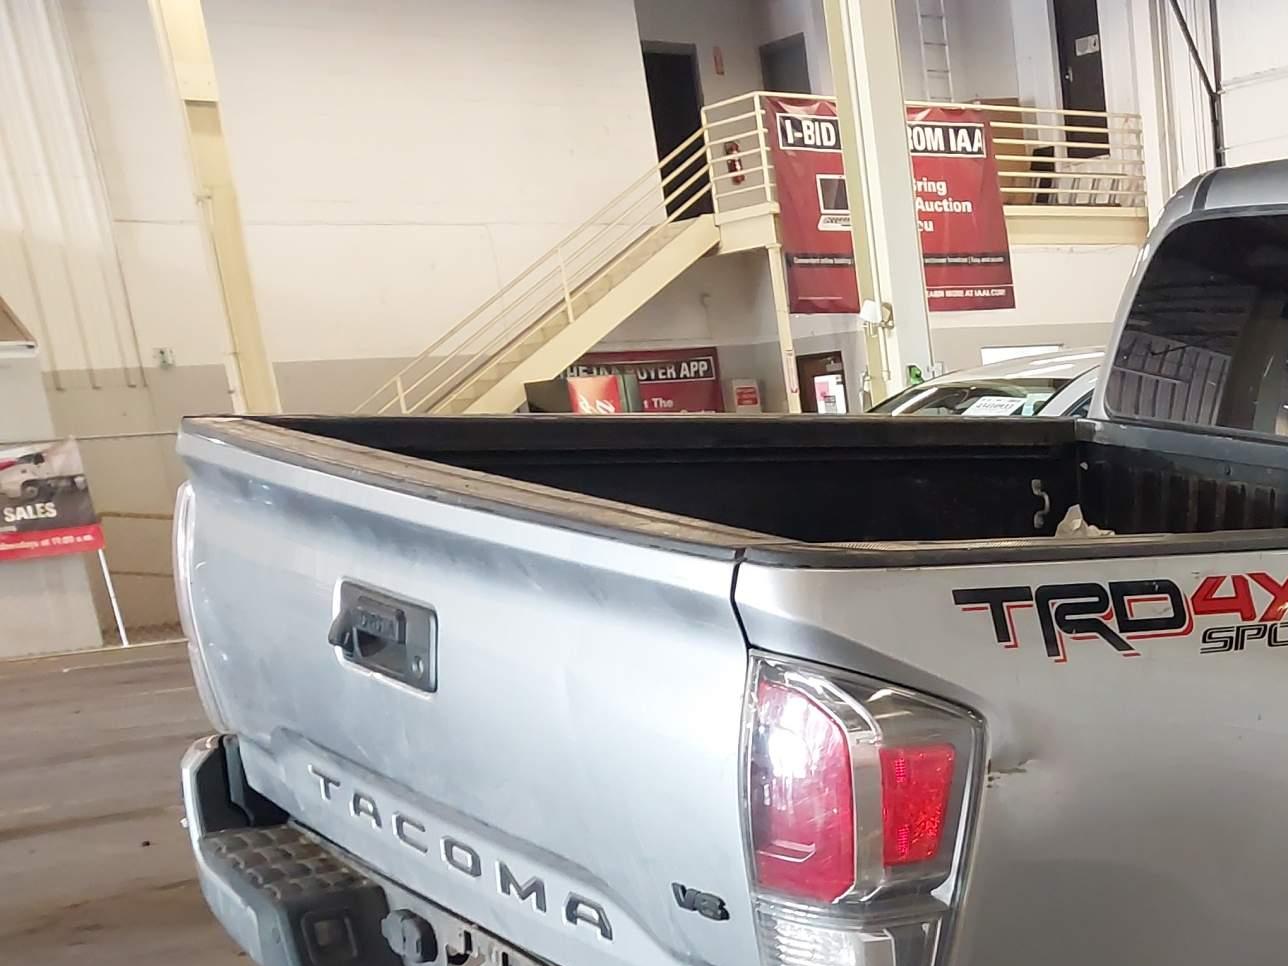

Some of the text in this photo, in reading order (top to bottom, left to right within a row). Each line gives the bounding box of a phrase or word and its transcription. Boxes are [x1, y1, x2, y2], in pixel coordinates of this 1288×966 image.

[784, 119, 837, 147] I-BID
[948, 127, 984, 152] IAA
[915, 196, 973, 213] Auction
[637, 364, 677, 380] UYER
[679, 361, 708, 378] APP
[3, 502, 57, 522] SALES
[952, 579, 1194, 663] TRD
[308, 764, 614, 942] TACOMA
